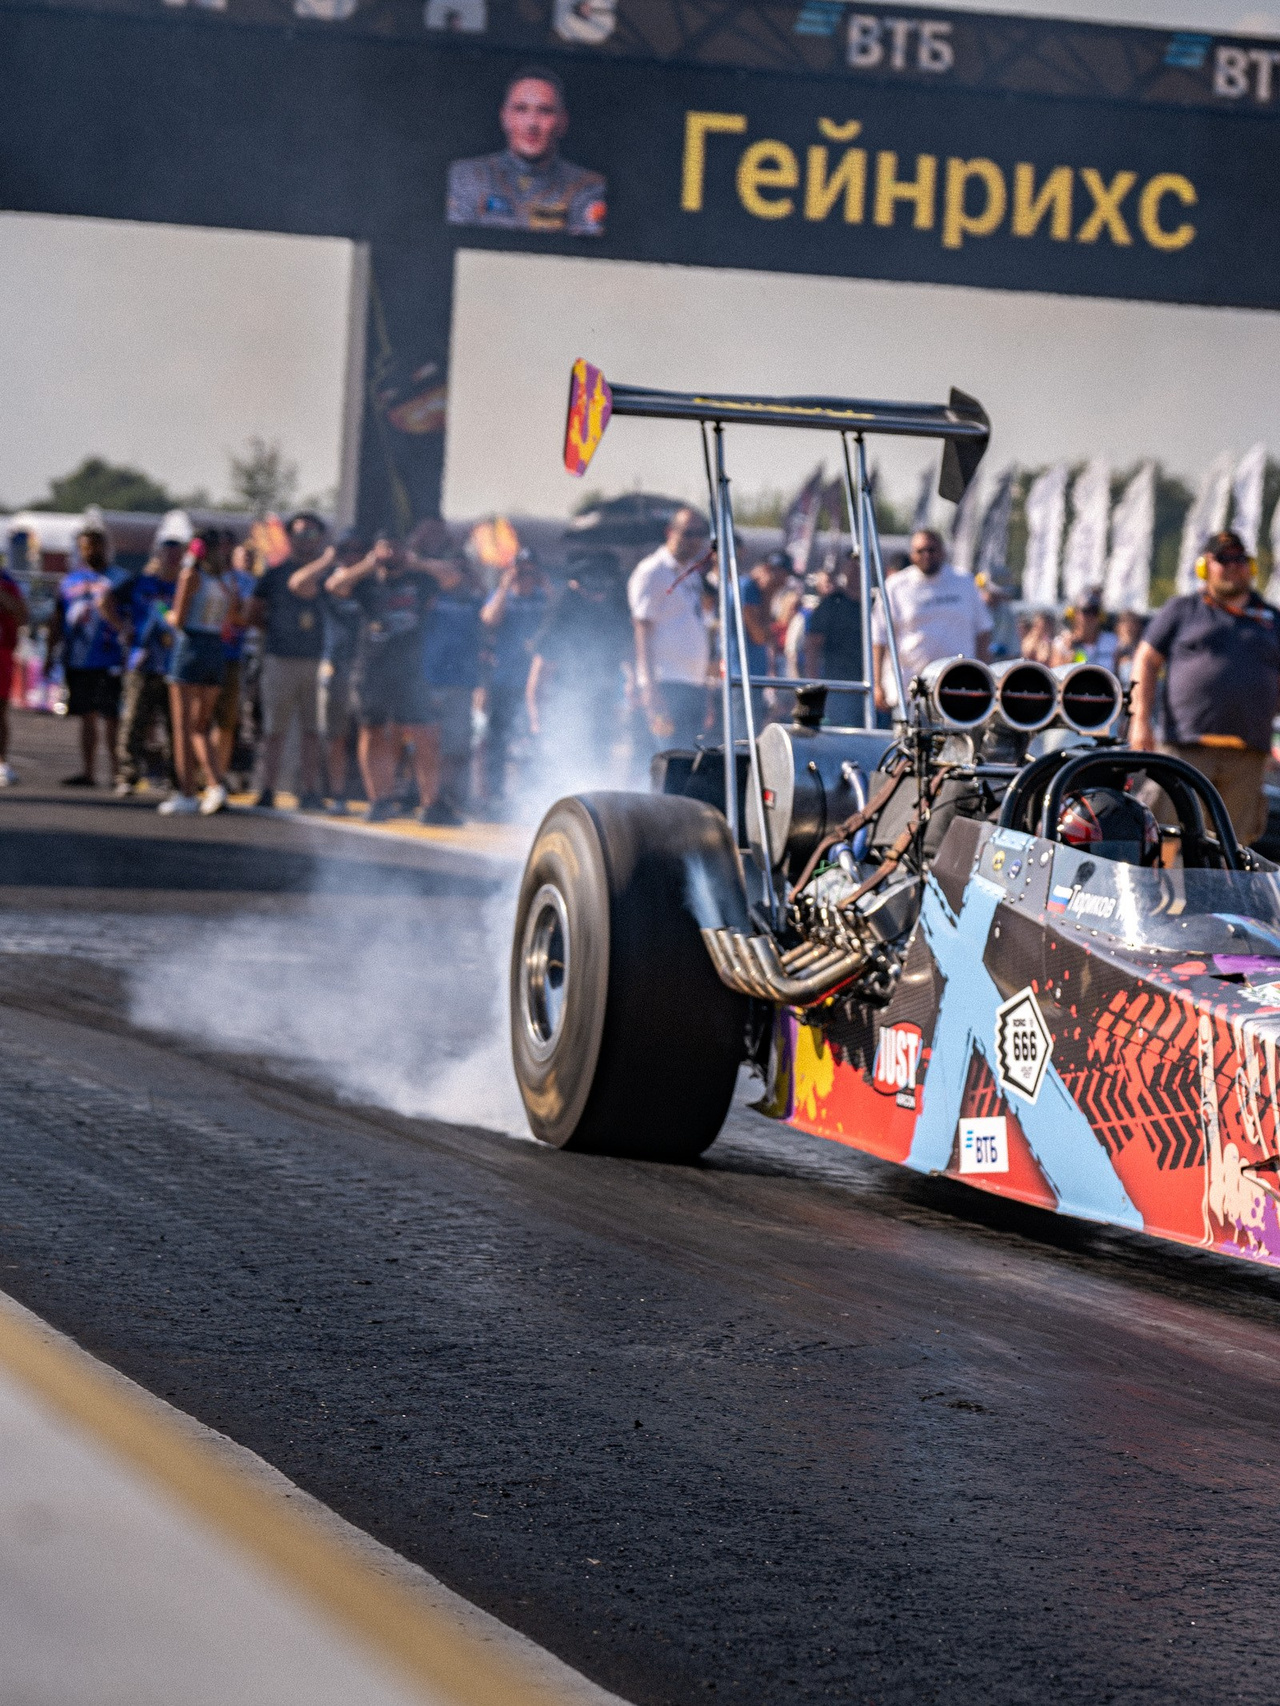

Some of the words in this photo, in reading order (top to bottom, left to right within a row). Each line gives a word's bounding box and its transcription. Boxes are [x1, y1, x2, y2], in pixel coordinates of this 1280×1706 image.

[847, 14, 954, 73] ВТБ
[681, 111, 1198, 252] Гейнрихс
[877, 1026, 920, 1090] JUST
[1013, 1030, 1038, 1062] 666
[976, 1135, 998, 1163] ВТБ
